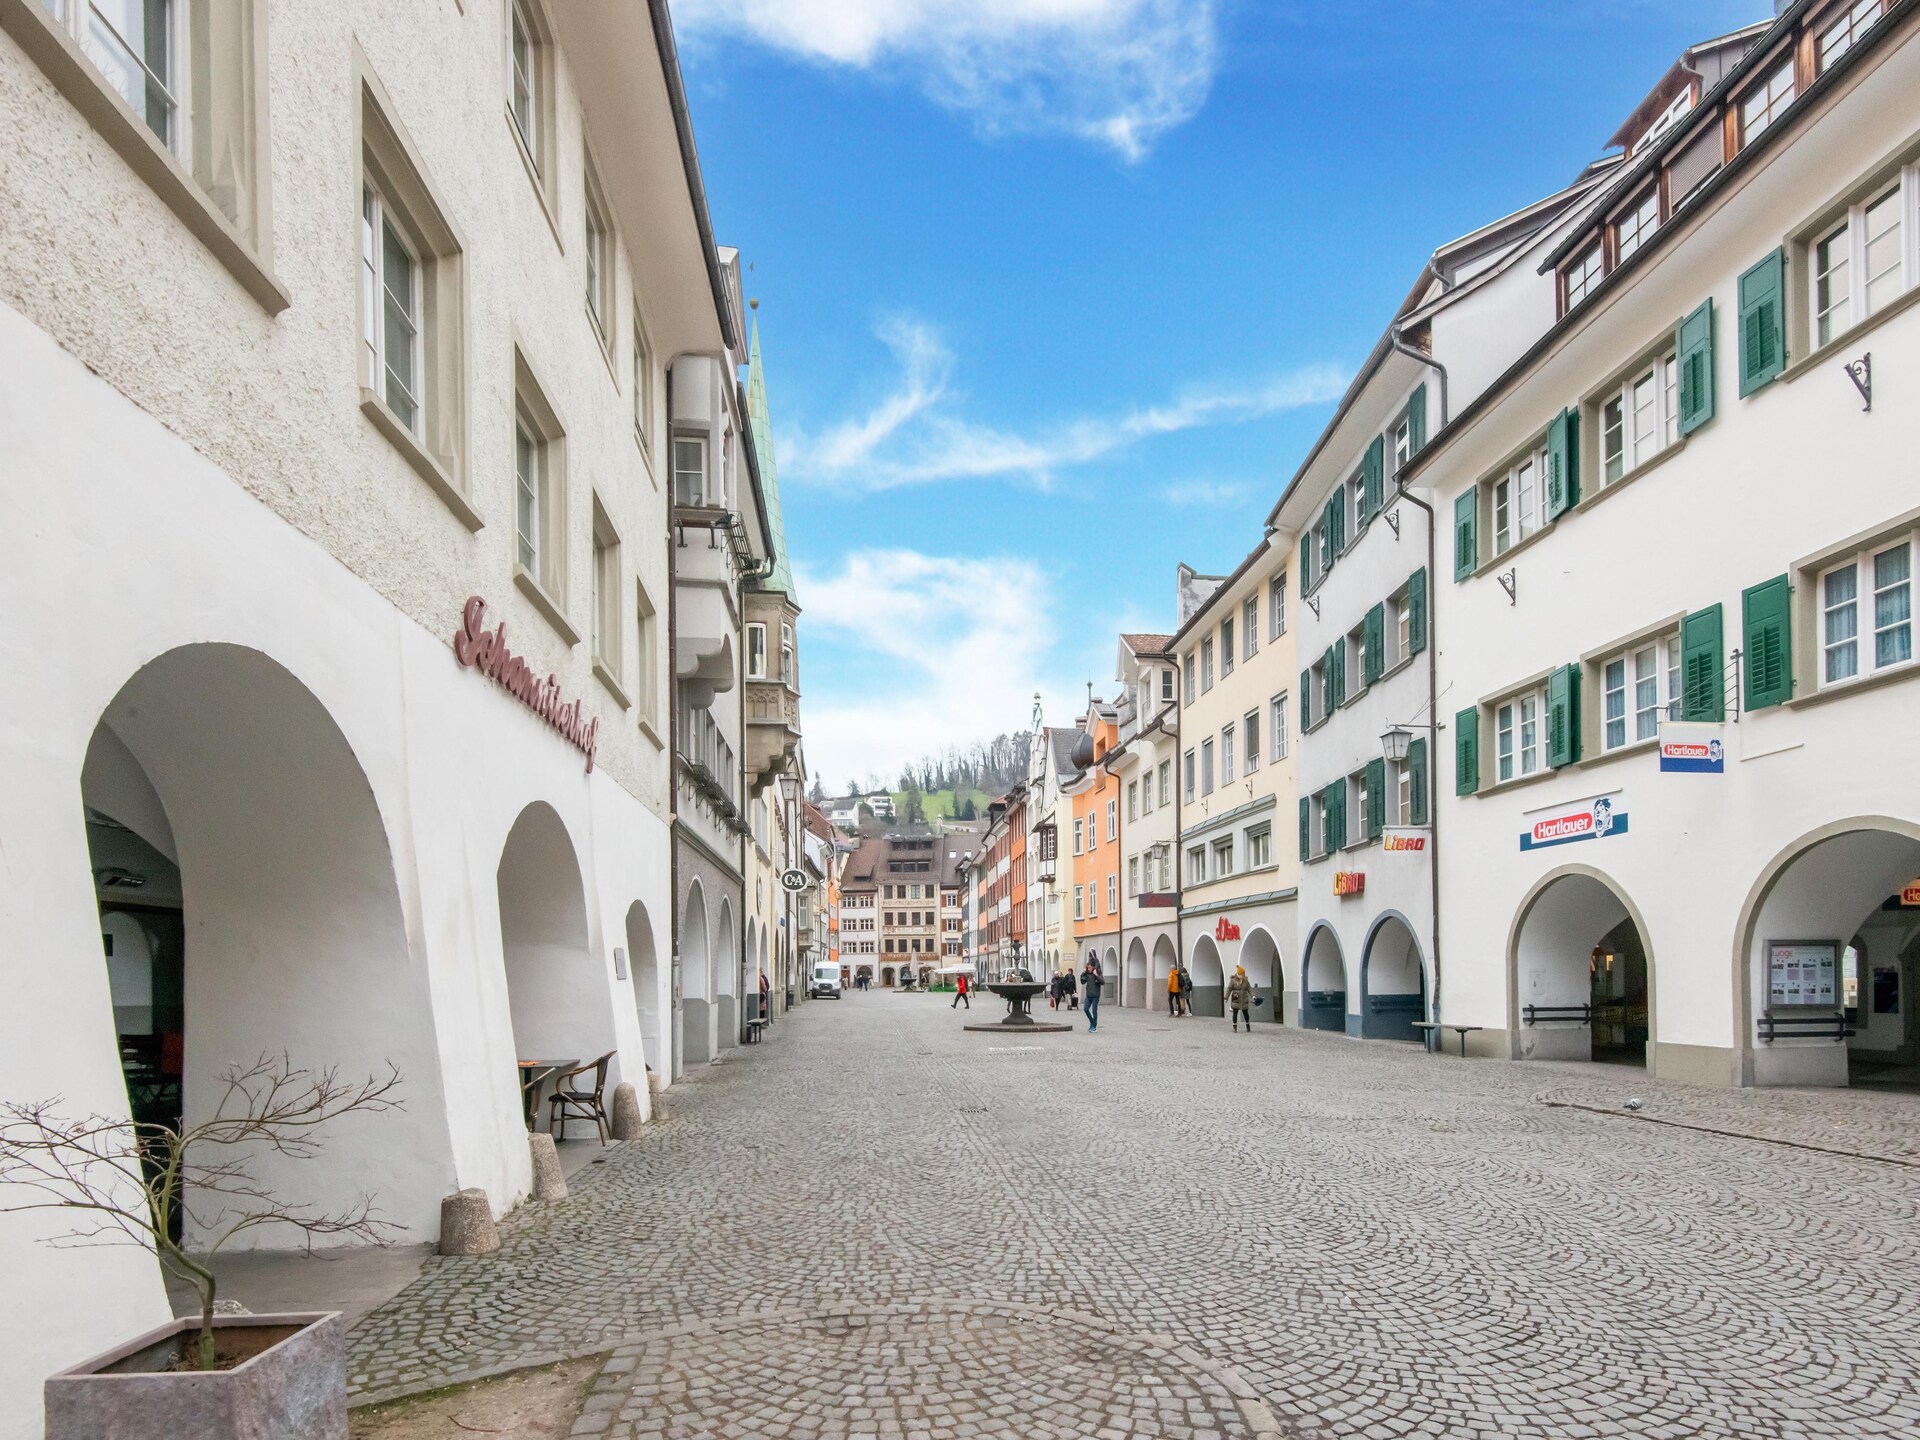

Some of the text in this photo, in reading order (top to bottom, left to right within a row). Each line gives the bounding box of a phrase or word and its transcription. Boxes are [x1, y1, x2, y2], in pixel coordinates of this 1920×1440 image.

[1667, 744, 1707, 756] Hartlauer
[1537, 817, 1589, 838] Hartlauer
[784, 874, 804, 886] C&A
